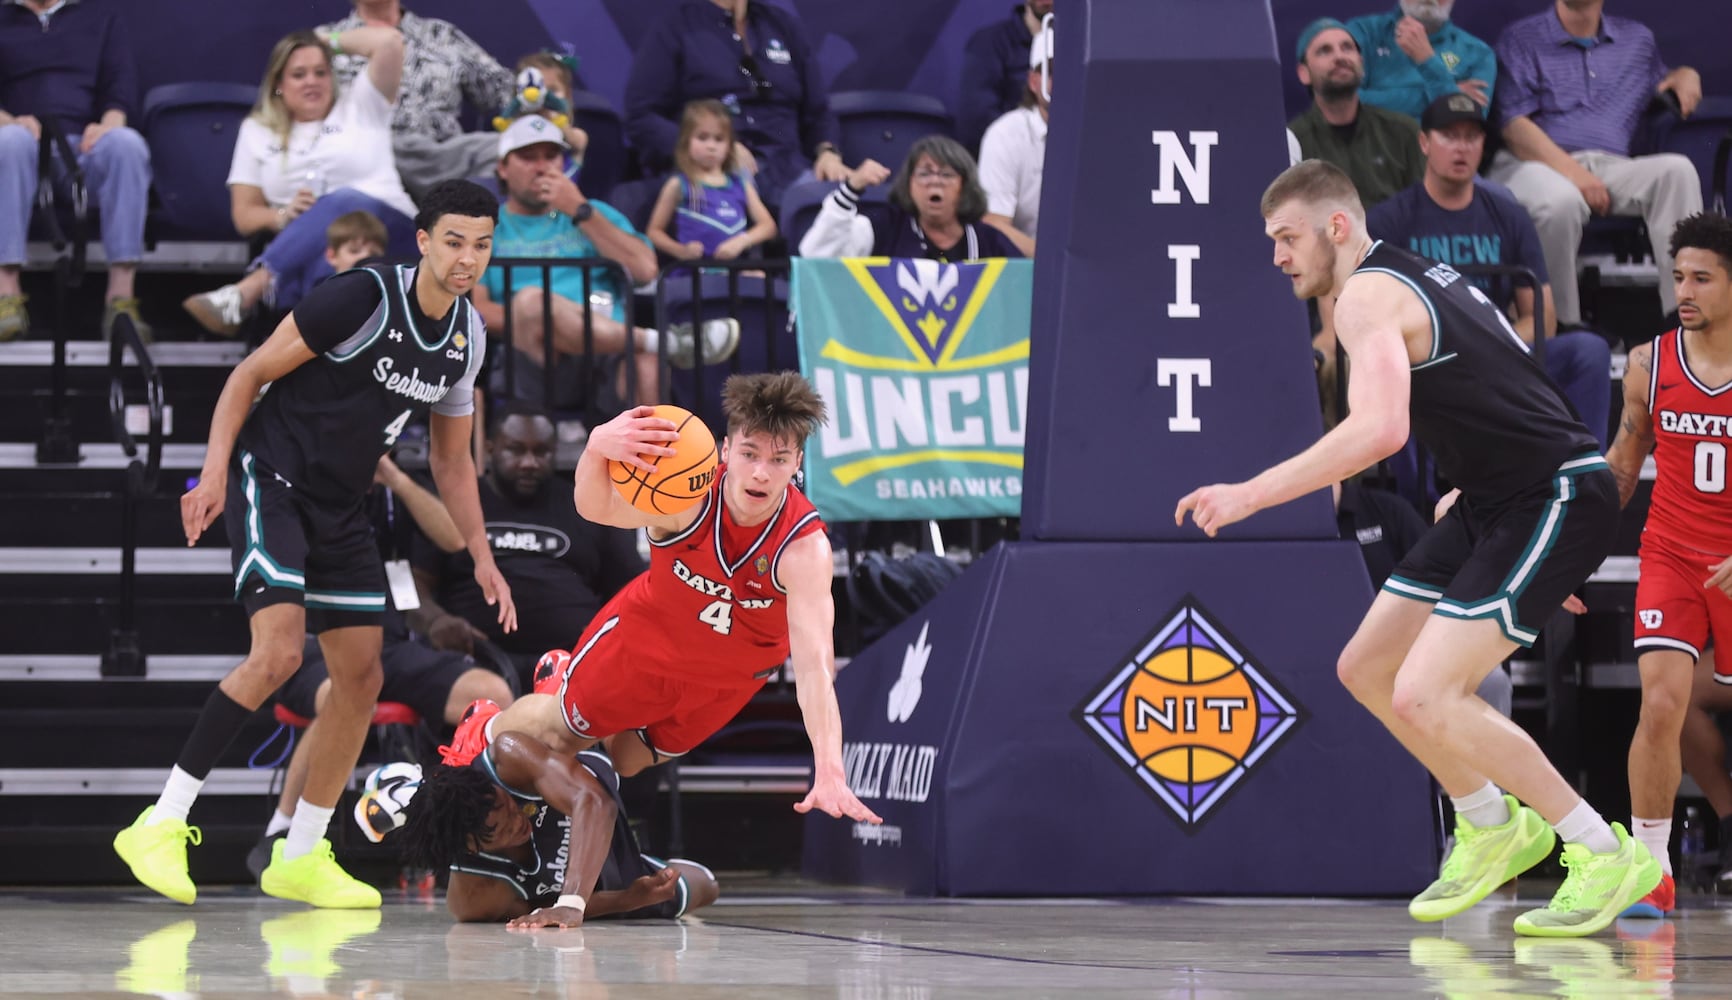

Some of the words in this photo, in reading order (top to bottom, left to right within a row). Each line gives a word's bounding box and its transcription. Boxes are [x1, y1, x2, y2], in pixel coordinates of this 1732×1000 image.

[1151, 130, 1219, 433] NIT
[384, 409, 412, 445] 4
[876, 477, 1022, 499] SEAHAWKS
[1694, 441, 1726, 493] 0
[673, 559, 774, 610] DAYTN
[699, 600, 733, 635] 4
[1135, 697, 1246, 733] NIT
[886, 744, 935, 803] MAID
